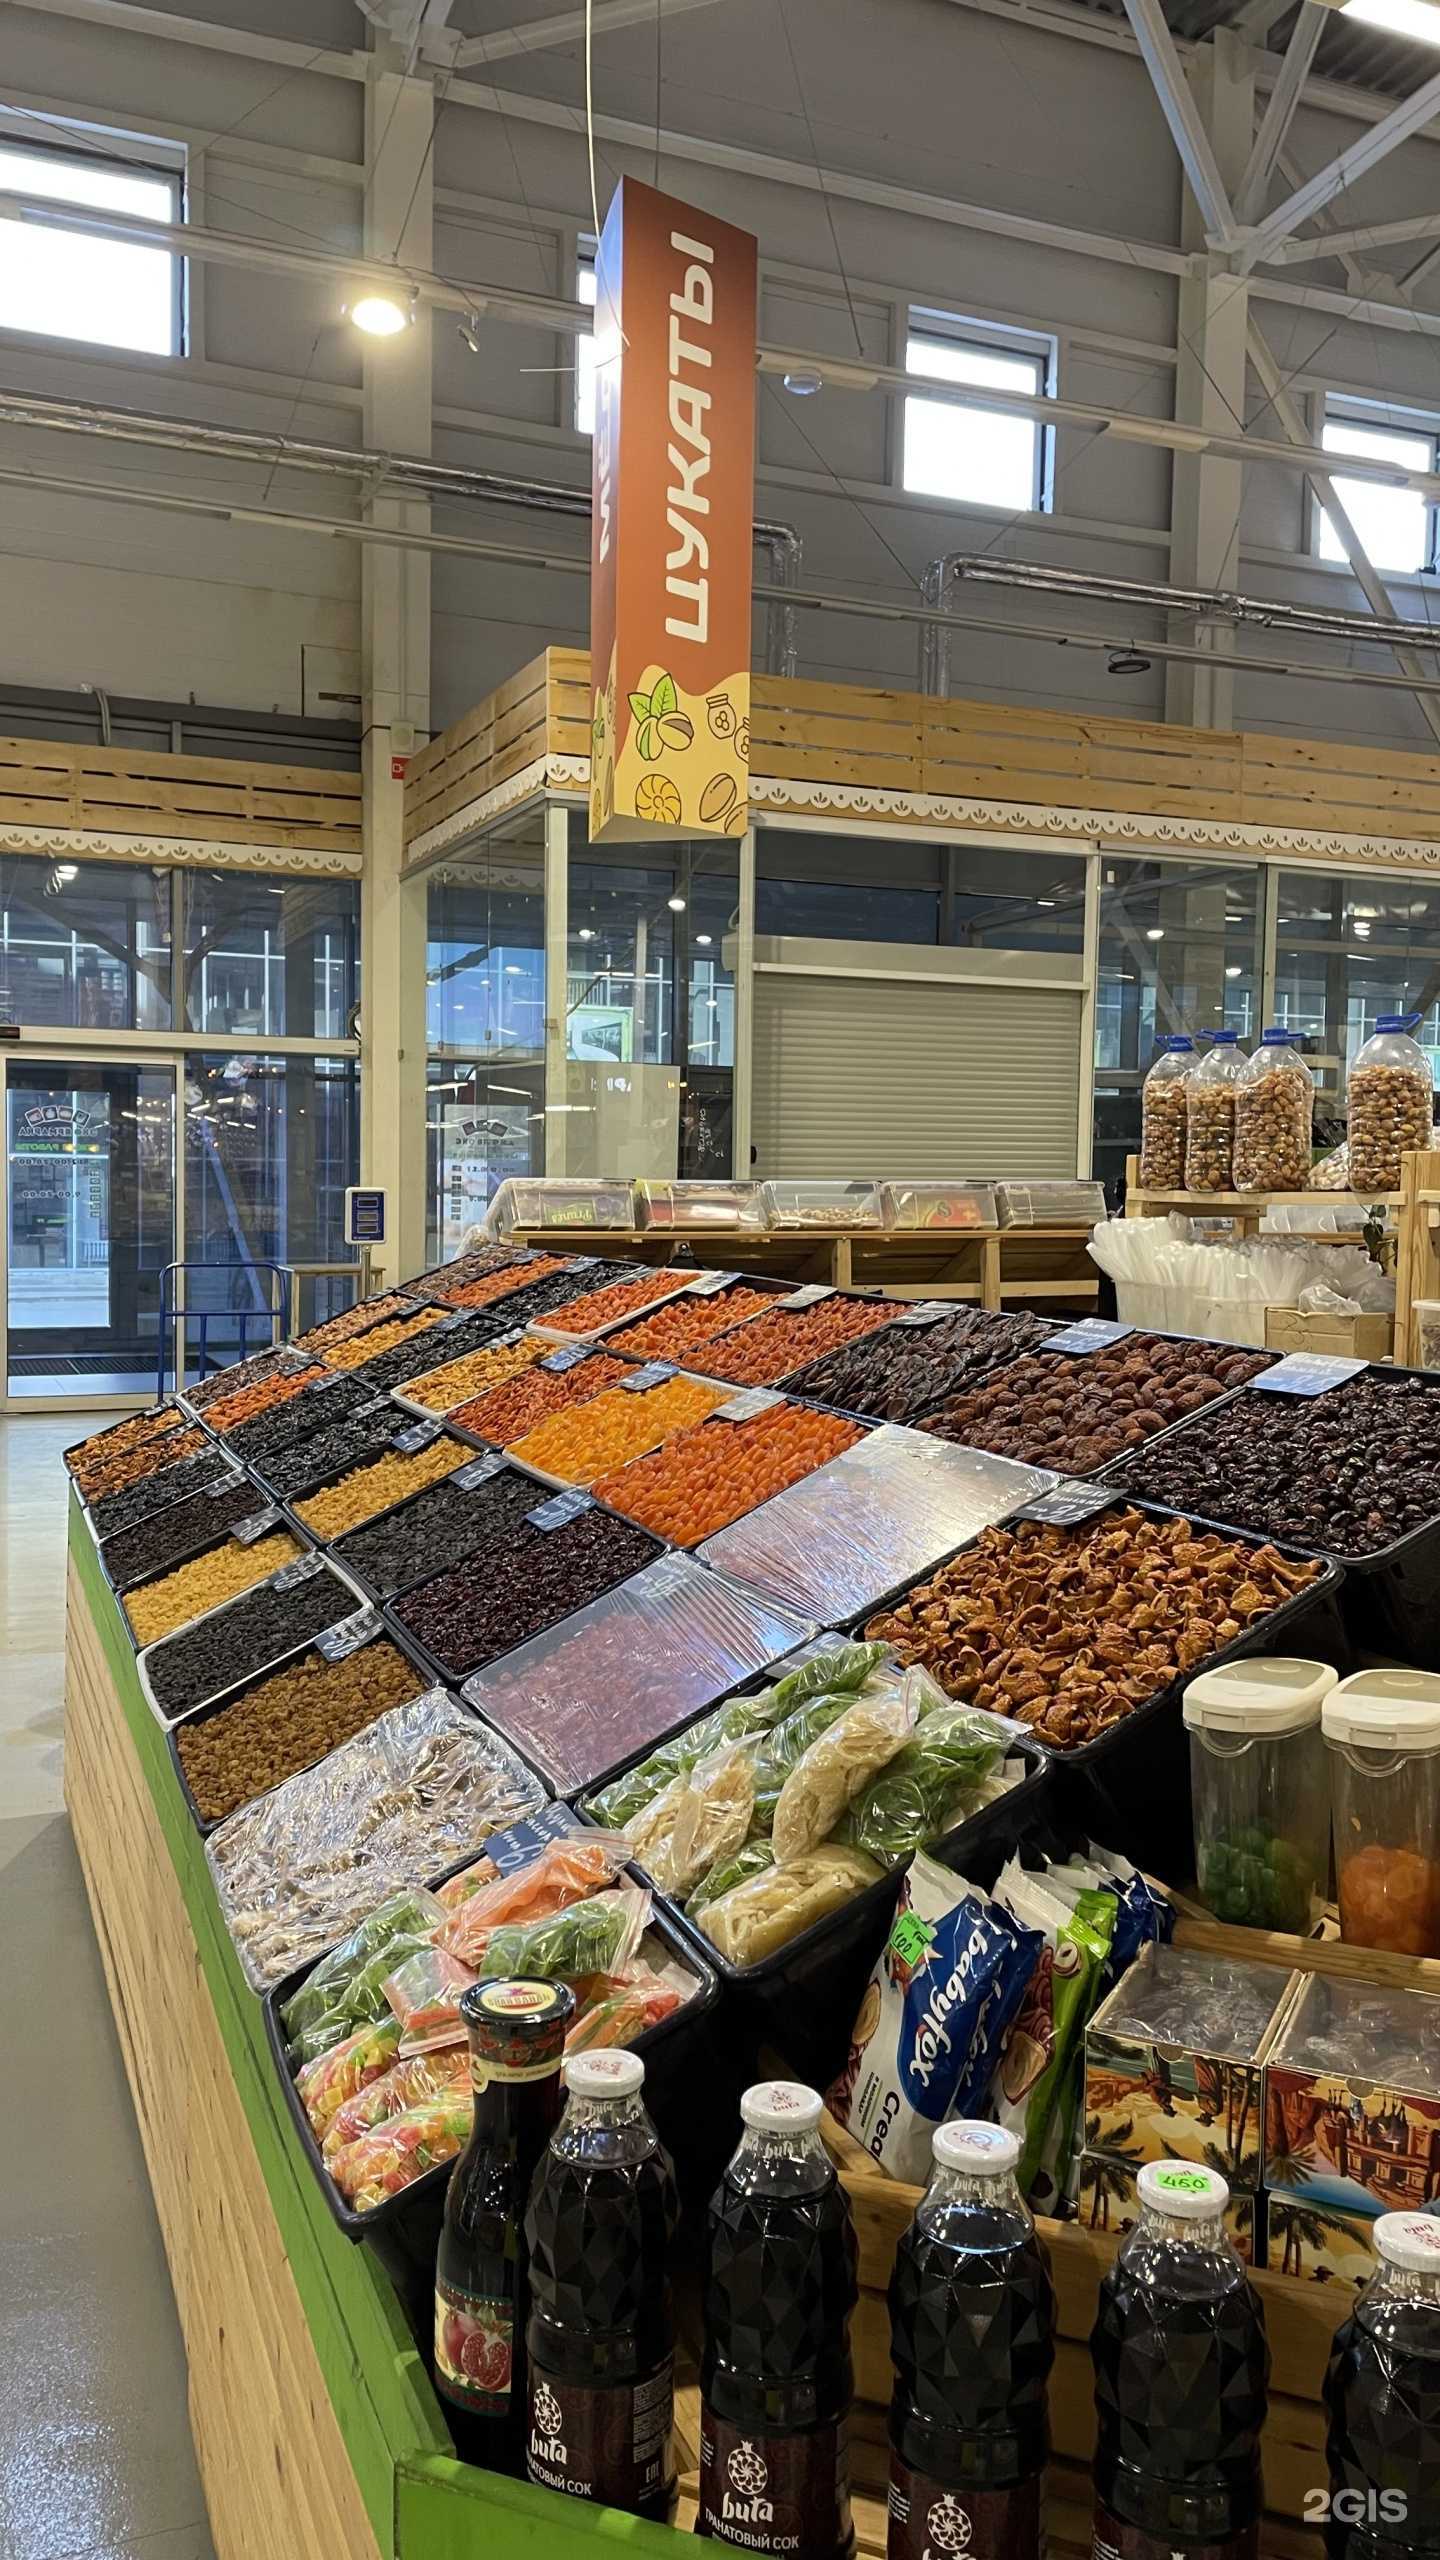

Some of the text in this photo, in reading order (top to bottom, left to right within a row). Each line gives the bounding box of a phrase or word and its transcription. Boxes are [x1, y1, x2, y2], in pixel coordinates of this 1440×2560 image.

[665, 231, 716, 644] ЦУКАТЫ
[910, 1926, 988, 2089] babyfox
[530, 2428, 568, 2465] buta
[566, 2479, 593, 2496] СОК
[722, 2491, 774, 2523] buta
[705, 2507, 800, 2551] ГРАНАТОВЫЙ СОК
